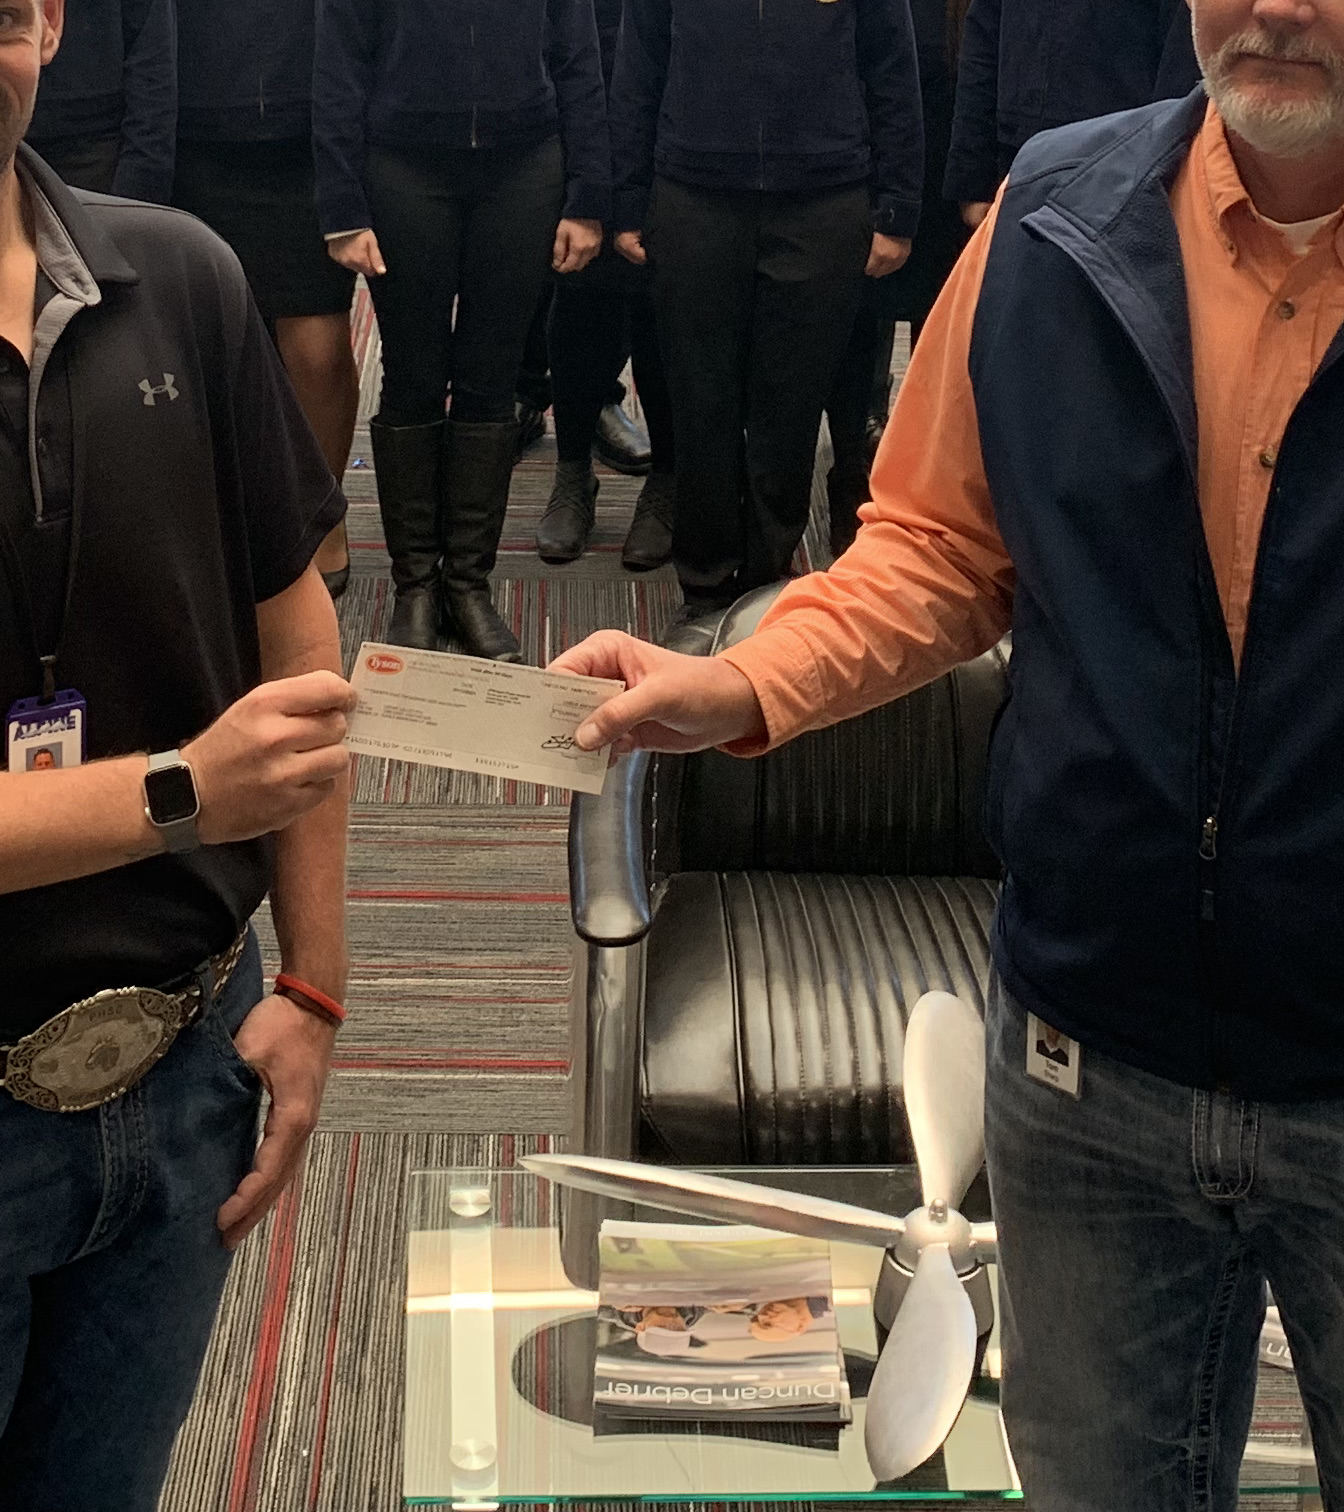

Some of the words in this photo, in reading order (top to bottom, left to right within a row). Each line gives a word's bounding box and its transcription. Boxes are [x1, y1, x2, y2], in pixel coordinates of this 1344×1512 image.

[370, 656, 402, 670] Tyson
[602, 1380, 713, 1405] Debrief
[721, 1381, 836, 1402] Duncan
